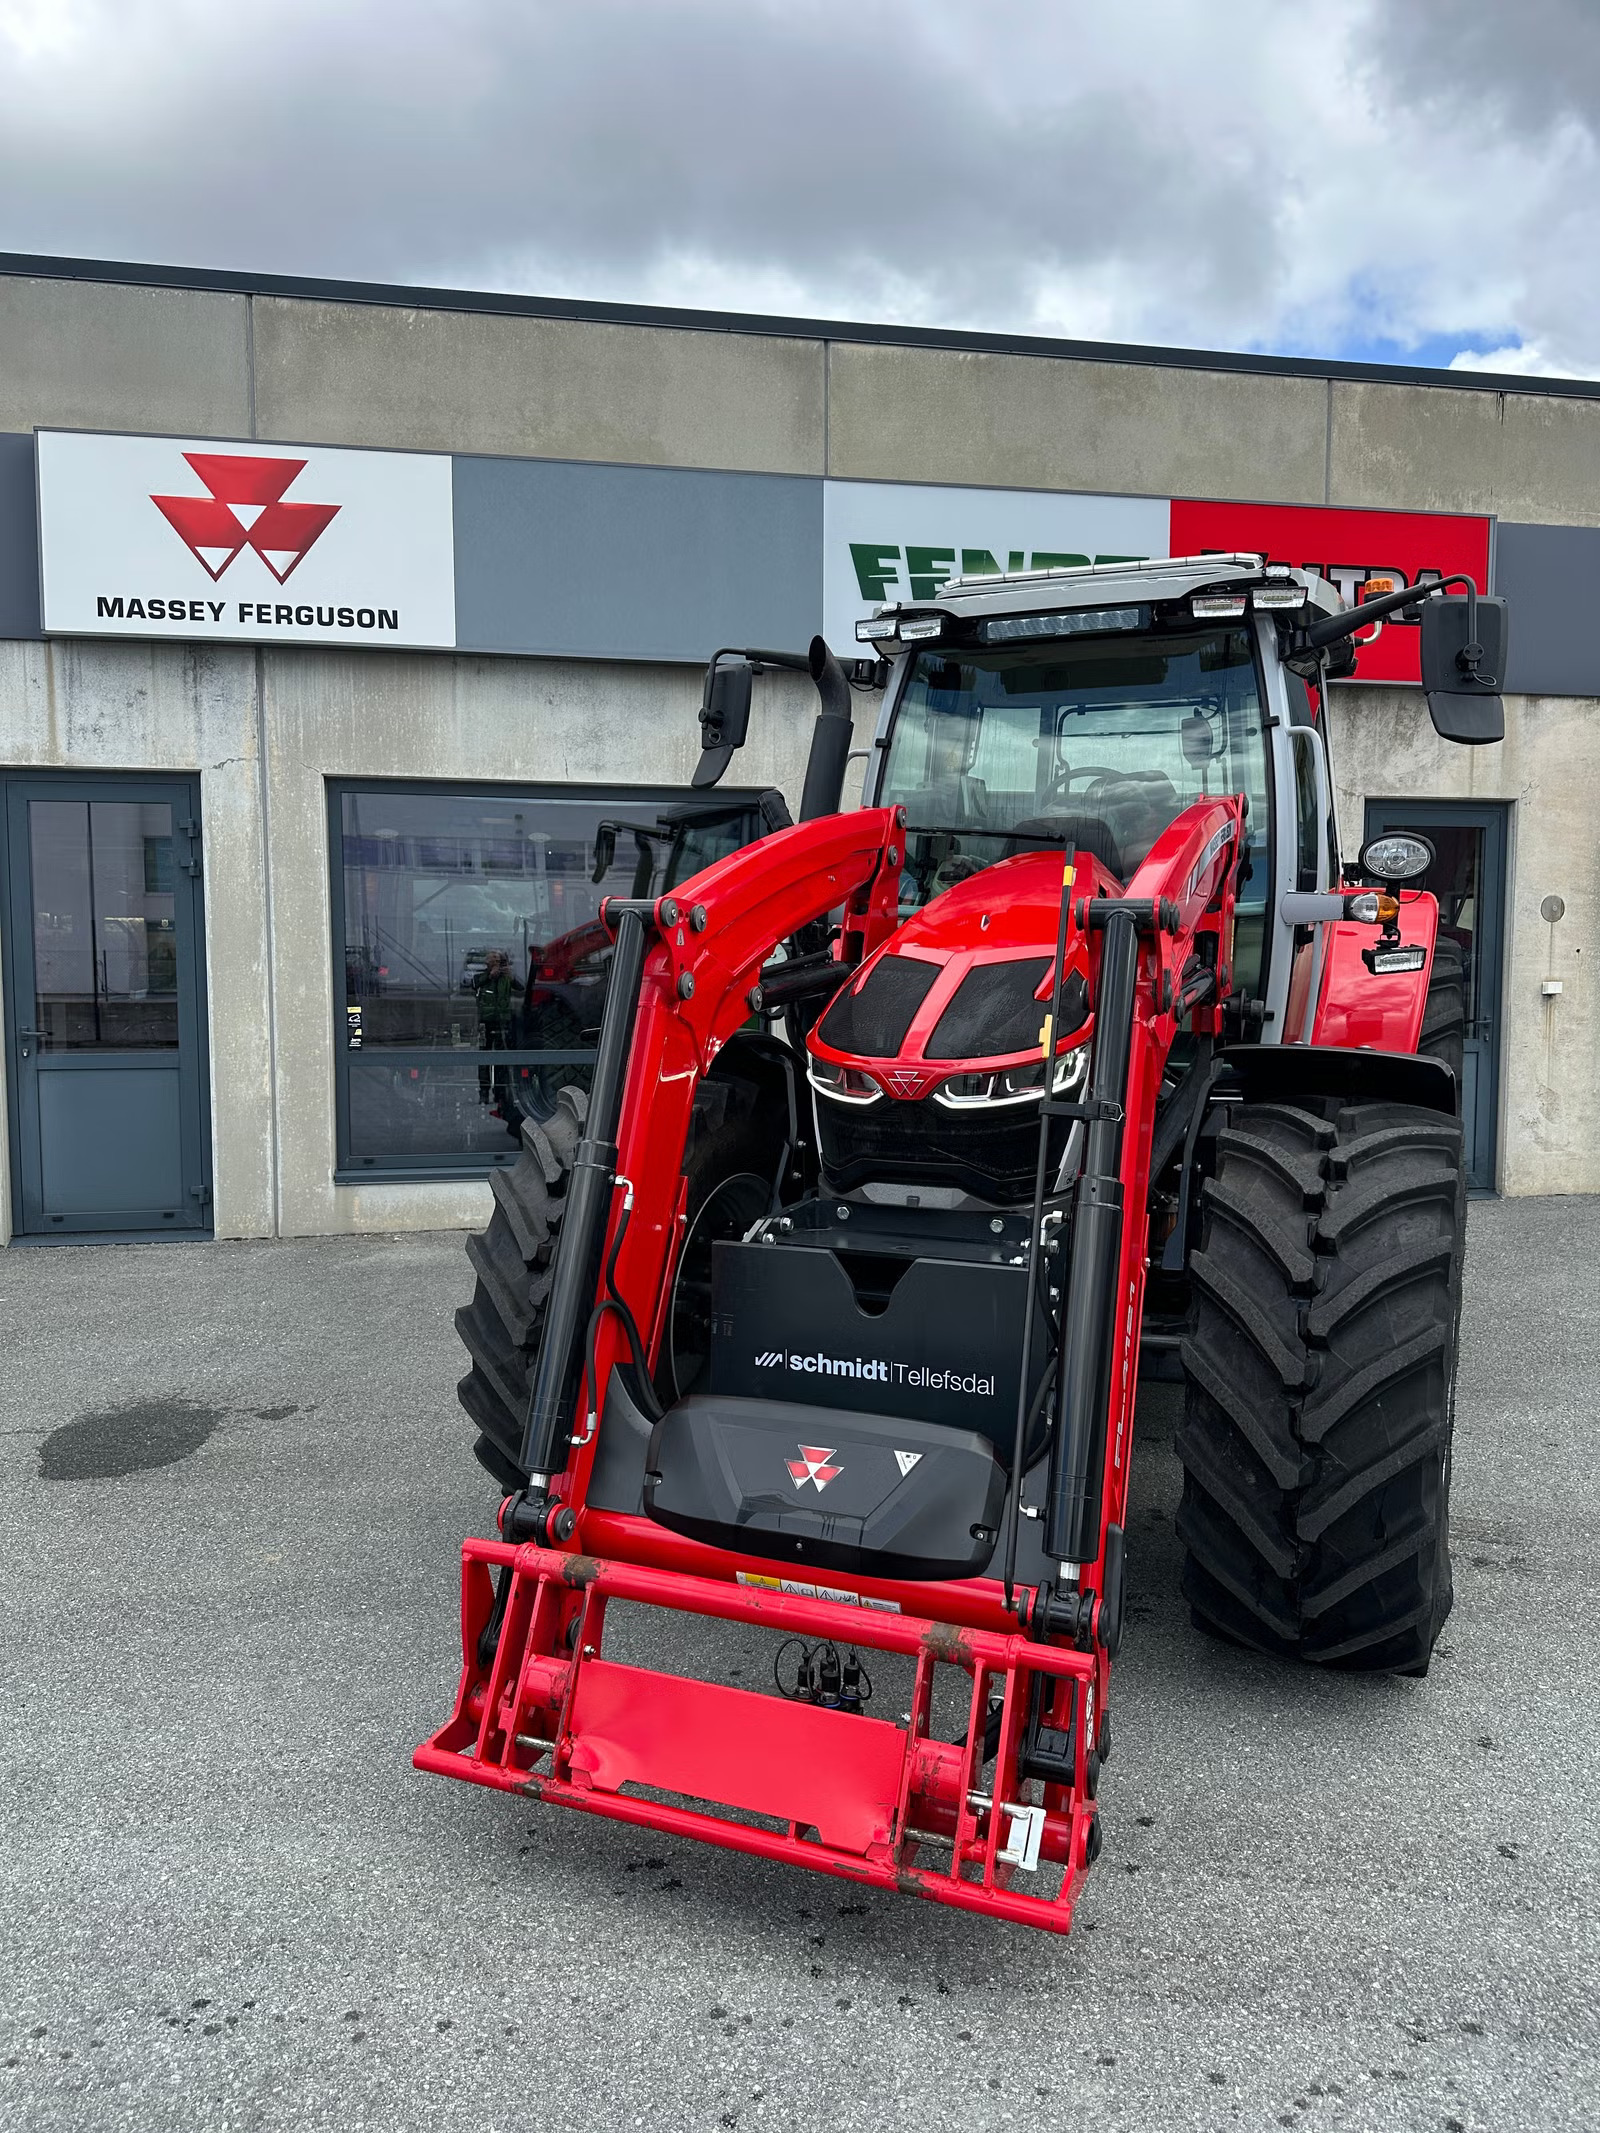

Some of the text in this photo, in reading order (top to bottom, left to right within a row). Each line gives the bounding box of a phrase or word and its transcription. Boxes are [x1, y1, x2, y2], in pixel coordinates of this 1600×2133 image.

[96, 596, 399, 630] MASSEY FERGUSON
[790, 1353, 996, 1396] schmidt Tellefsdal
